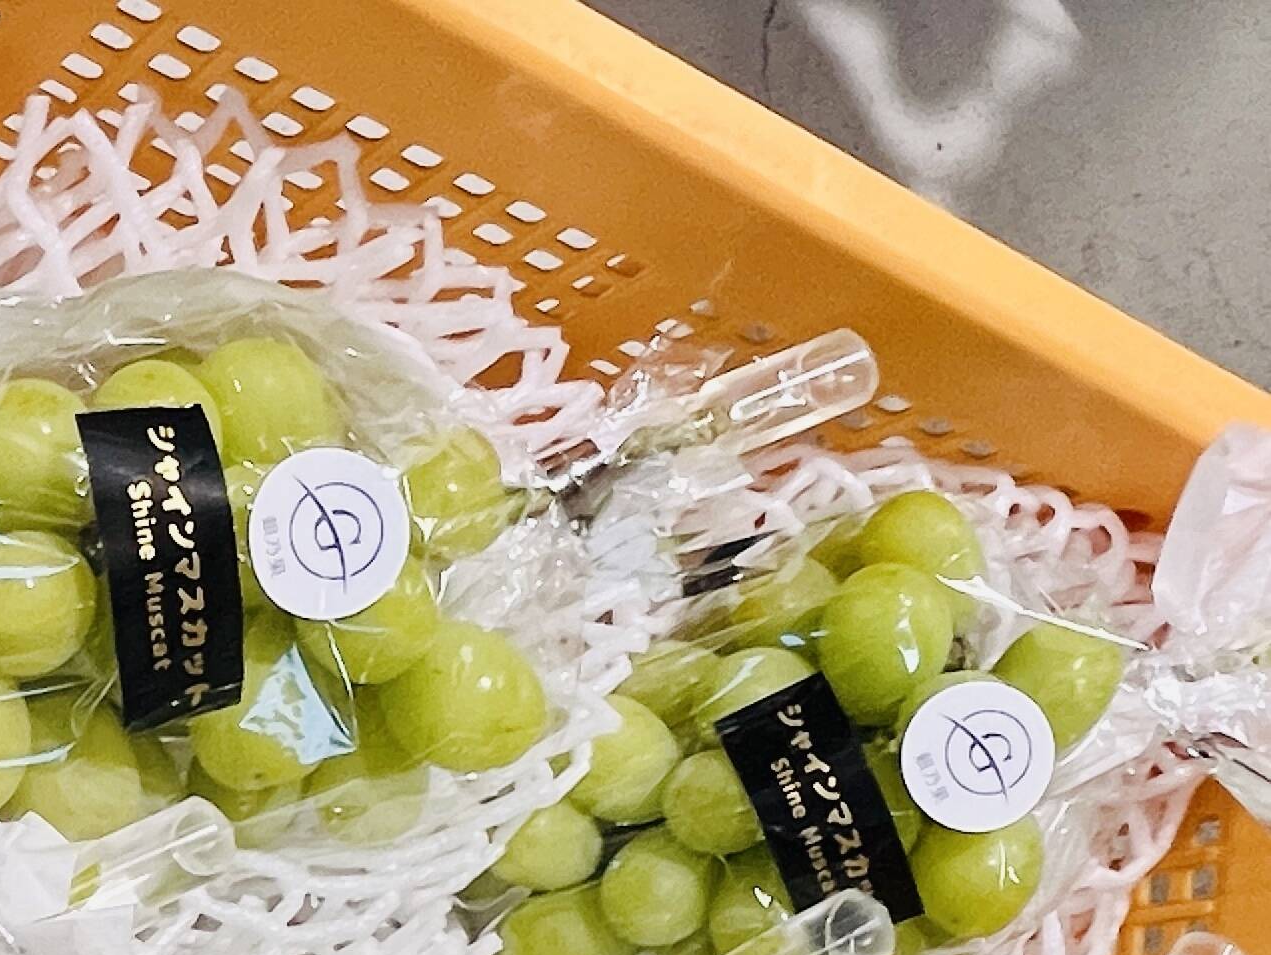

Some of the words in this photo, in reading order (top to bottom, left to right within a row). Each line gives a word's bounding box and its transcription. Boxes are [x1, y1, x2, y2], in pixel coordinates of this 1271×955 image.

[127, 481, 156, 561] Shine
[144, 572, 173, 671] Muscat
[147, 426, 211, 706] シャインマスカット
[770, 758, 807, 819] Shine
[796, 825, 837, 893] Musca
[777, 704, 874, 895] シャインマスカ
